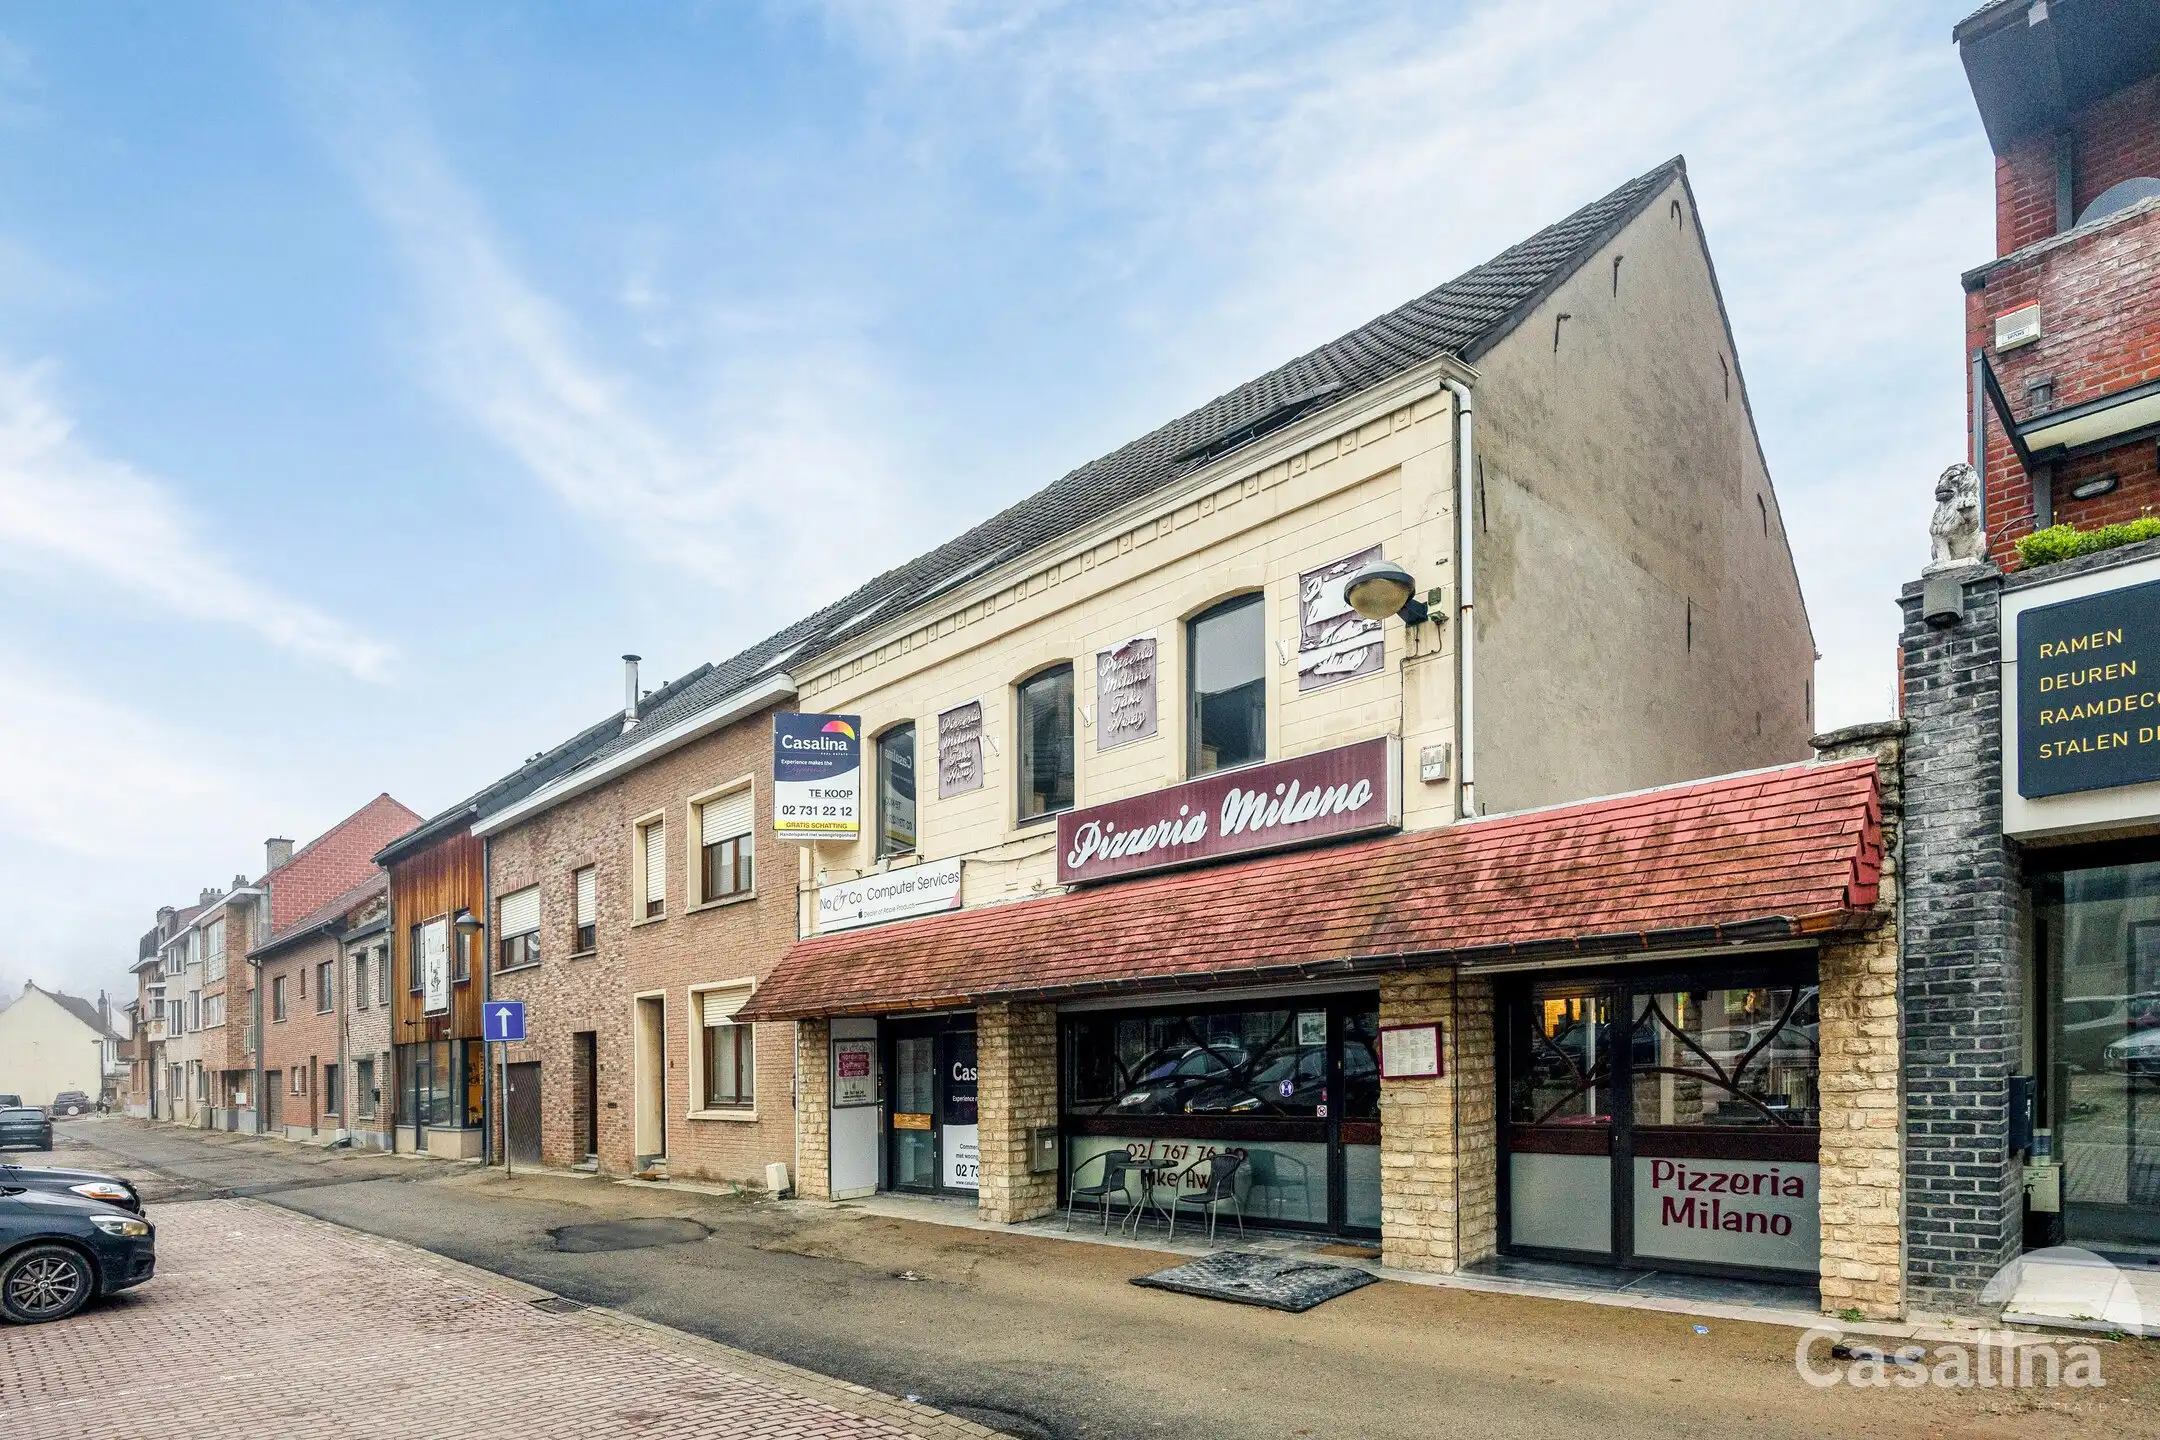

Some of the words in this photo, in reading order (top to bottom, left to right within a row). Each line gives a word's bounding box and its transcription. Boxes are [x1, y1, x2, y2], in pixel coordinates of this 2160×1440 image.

[2040, 628, 2122, 659] RAMEN
[2040, 660, 2136, 693] DEUREN
[1111, 690, 1144, 714] Take
[2040, 691, 2160, 725] RAAMDEC
[1108, 711, 1146, 733] Away
[782, 734, 848, 751] Casalina
[2040, 731, 2128, 759] STALEN
[2139, 725, 2160, 744] D
[809, 789, 821, 798] TE
[825, 789, 853, 799] KOOP
[782, 805, 796, 815] 02
[799, 805, 818, 816] 731
[822, 806, 836, 816] 22
[840, 806, 852, 817] 12
[1067, 804, 1208, 869] Pizzeria
[1219, 778, 1373, 837] Milano
[786, 821, 810, 829] GRATIS
[820, 898, 831, 911] No
[848, 891, 862, 905] Co
[866, 880, 915, 901] Computer
[917, 871, 960, 890] Services
[1162, 1144, 1188, 1160] 767
[1197, 1146, 1215, 1161] 76
[956, 1164, 967, 1177] 02
[1650, 1159, 1804, 1198] Pizzeria
[1662, 1196, 1792, 1236] Milano
